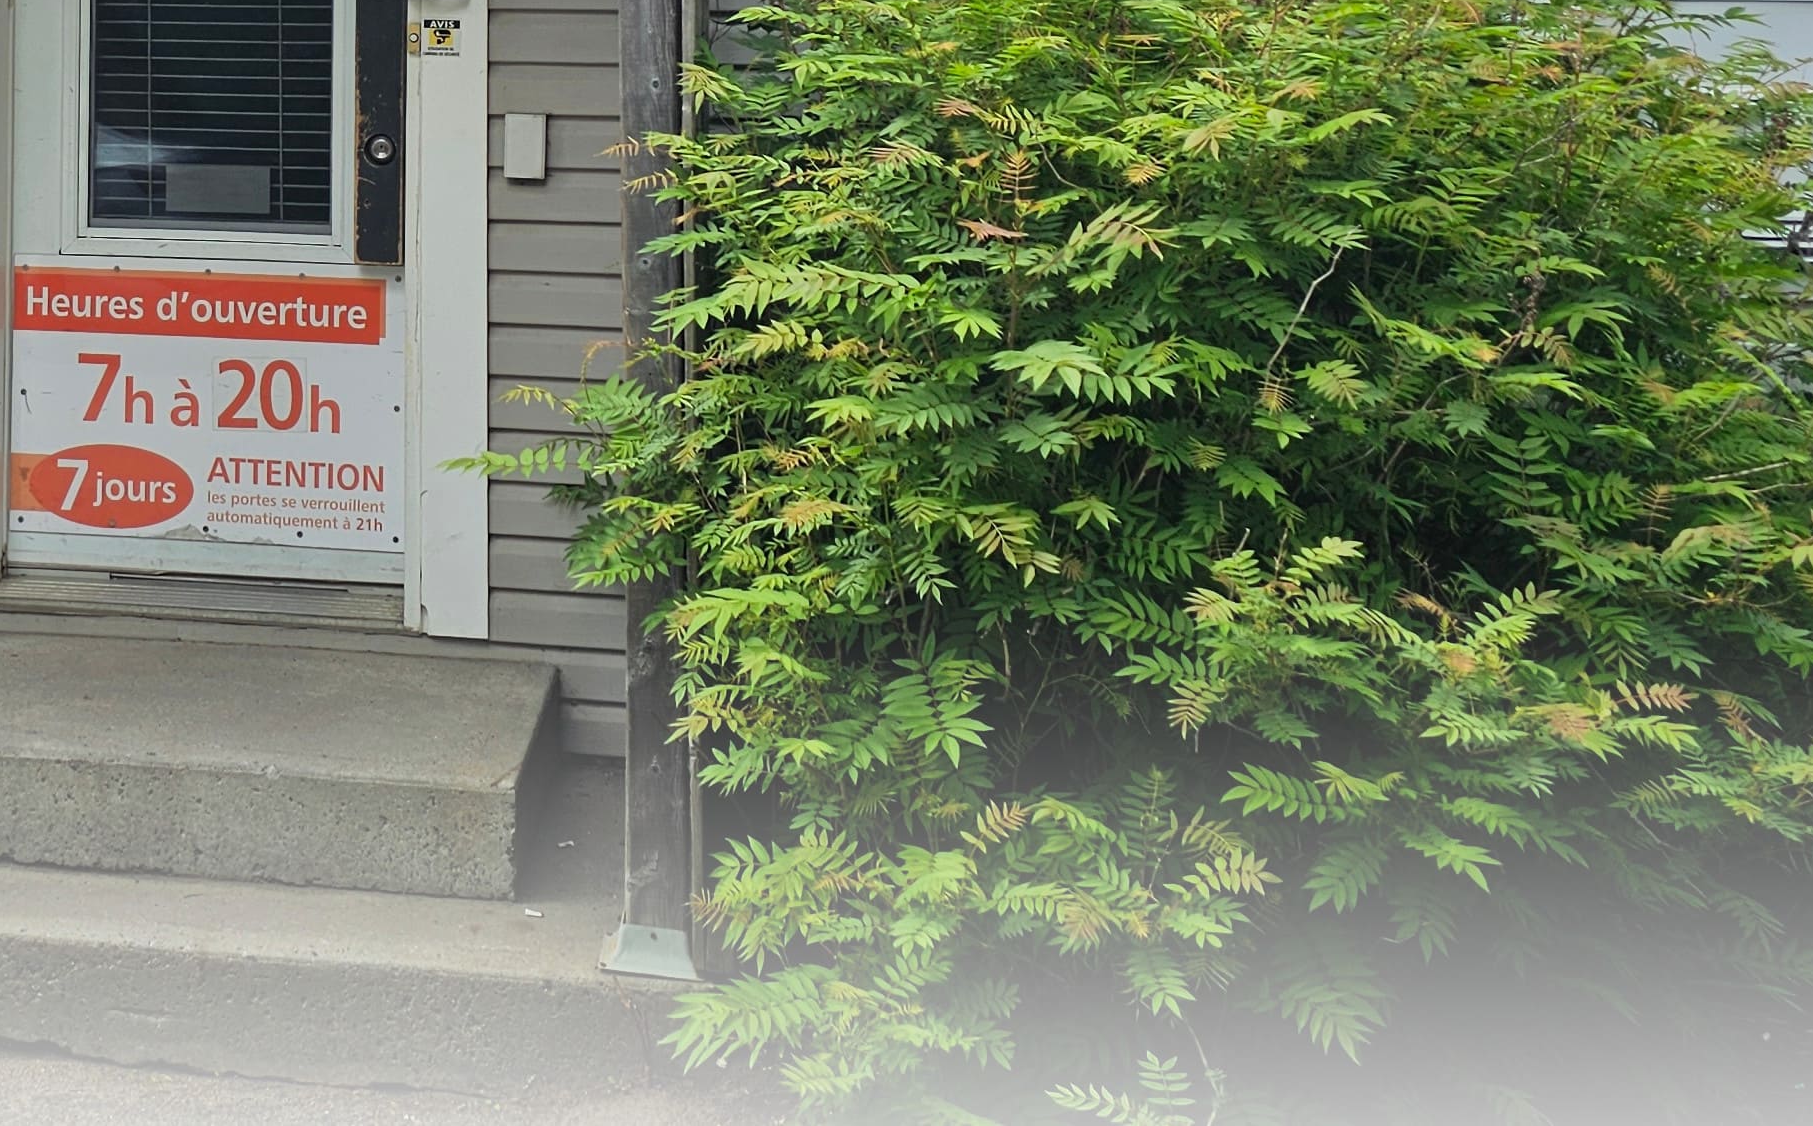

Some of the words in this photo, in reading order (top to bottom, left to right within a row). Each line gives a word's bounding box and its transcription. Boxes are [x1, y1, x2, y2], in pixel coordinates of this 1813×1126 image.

[429, 20, 455, 28] AVIS
[26, 285, 145, 321] Heures
[156, 290, 368, 330] d'ouverture
[78, 352, 154, 425] 7h
[170, 378, 199, 427] à
[217, 359, 341, 435] 20h
[56, 458, 88, 511] 7
[93, 472, 177, 507] jours
[206, 456, 384, 493] ATTENTION
[207, 490, 227, 505] les
[231, 493, 276, 510] portes
[281, 498, 297, 508] se
[301, 496, 385, 514] verrouillent
[207, 511, 338, 531] automatiquement
[342, 516, 351, 530] à
[356, 517, 383, 532] 21h
